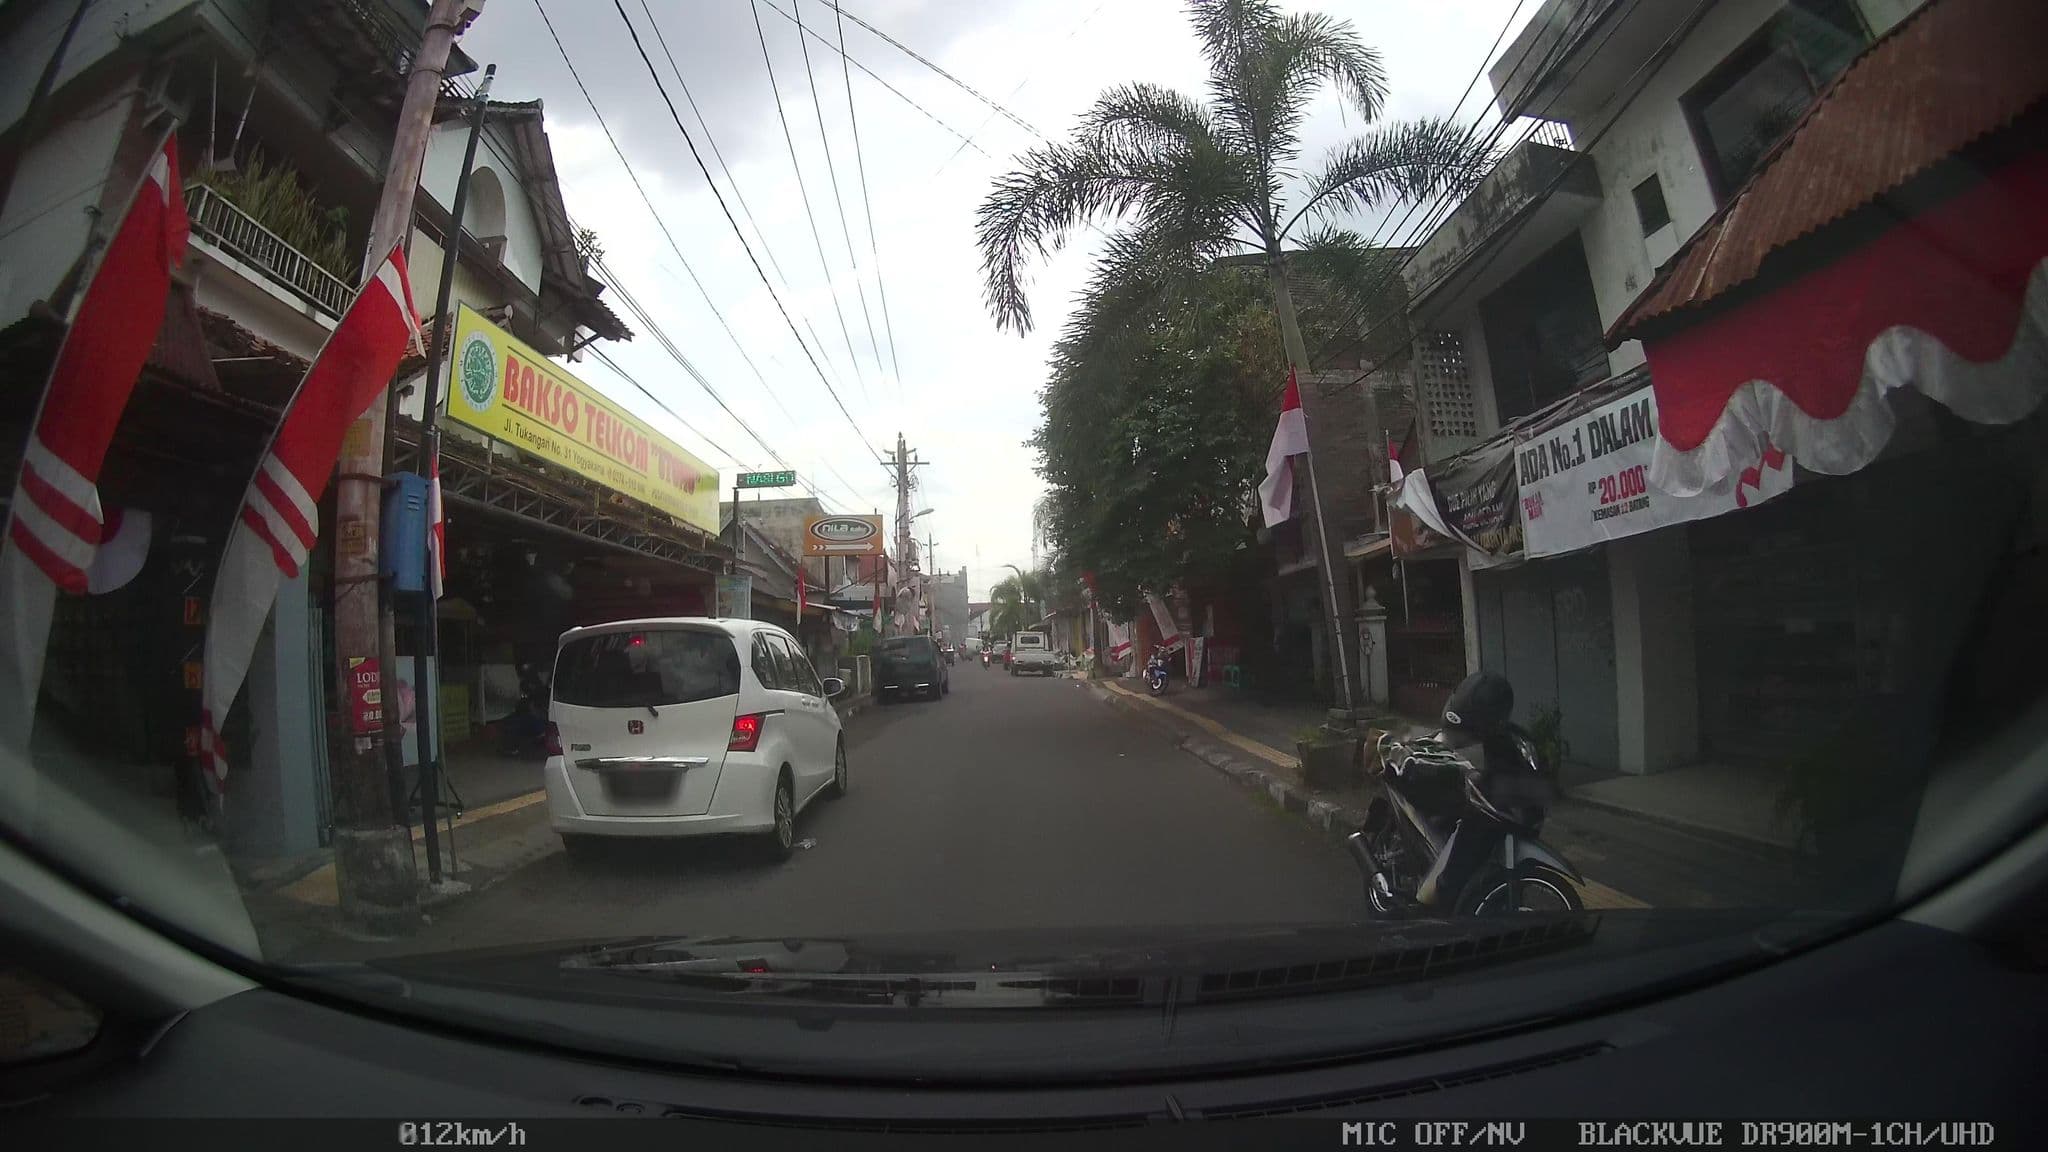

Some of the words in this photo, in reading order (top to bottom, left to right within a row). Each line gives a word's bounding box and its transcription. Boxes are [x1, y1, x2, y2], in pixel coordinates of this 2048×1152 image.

[504, 355, 578, 433] BAKSO
[585, 402, 648, 473] TELKOM
[515, 423, 550, 450] Tukangan
[1519, 444, 1550, 486] ADA
[1550, 427, 1586, 474] No.1
[1587, 398, 1654, 459] DALAM
